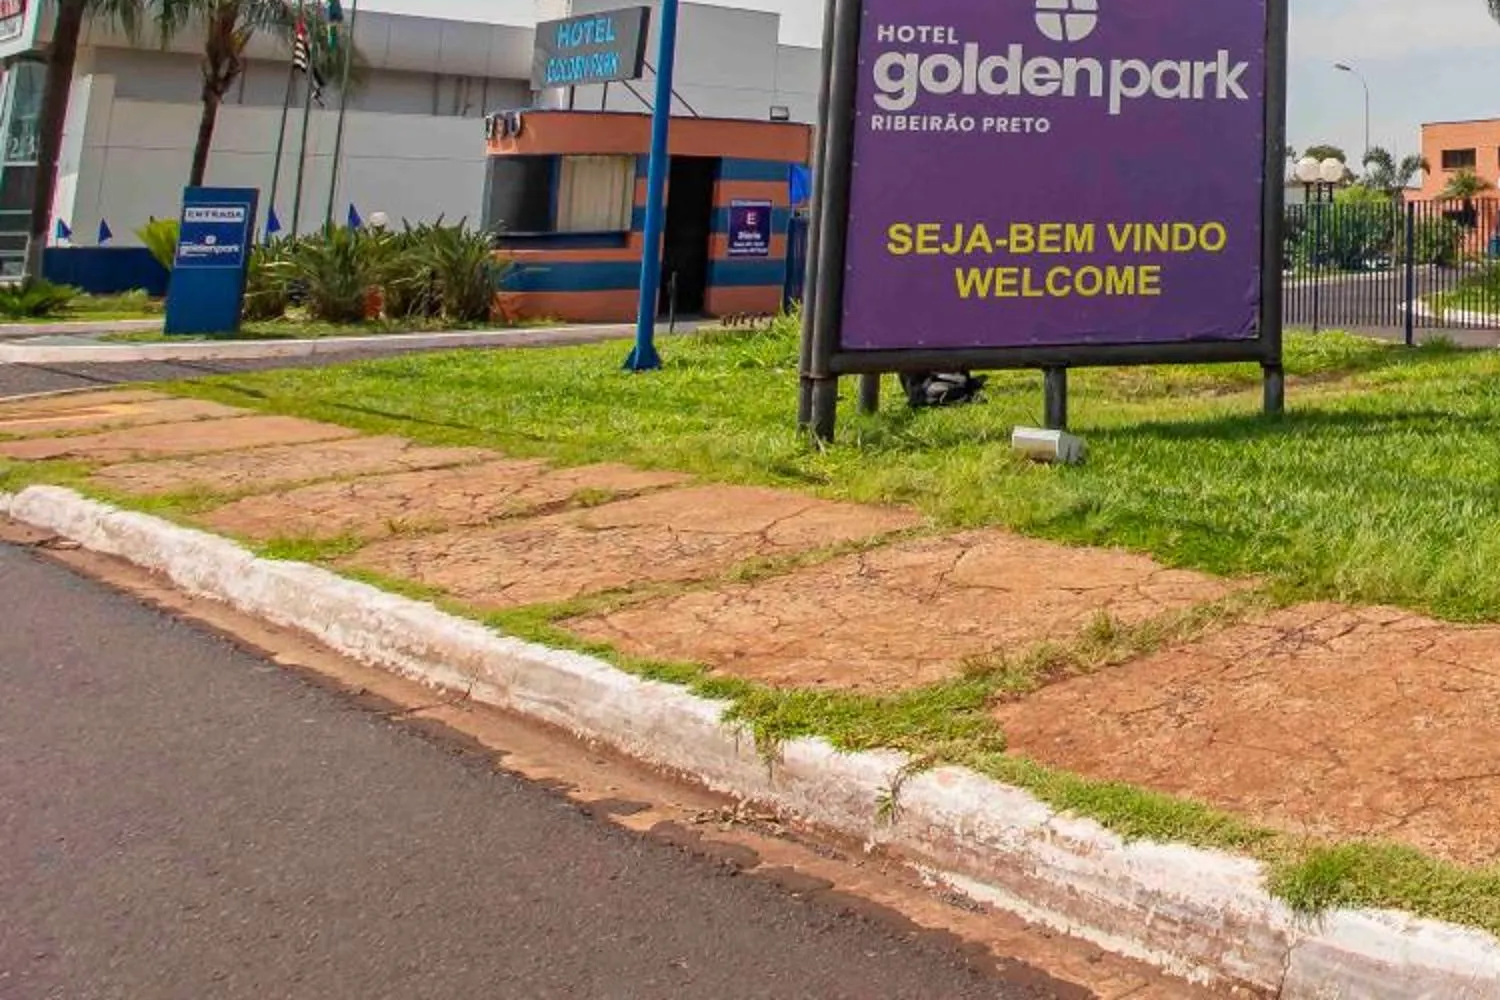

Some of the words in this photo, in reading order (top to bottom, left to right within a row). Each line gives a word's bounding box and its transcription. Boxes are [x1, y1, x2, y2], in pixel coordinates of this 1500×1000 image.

[557, 16, 615, 48] HOTEL
[877, 24, 959, 45] HOTEL
[871, 113, 976, 132] RIBEIRÃO
[982, 116, 1051, 133] PRETO
[886, 222, 1096, 256] SEJA-BEM
[1106, 221, 1227, 253] VINDO
[955, 264, 1162, 299] WELCOME
